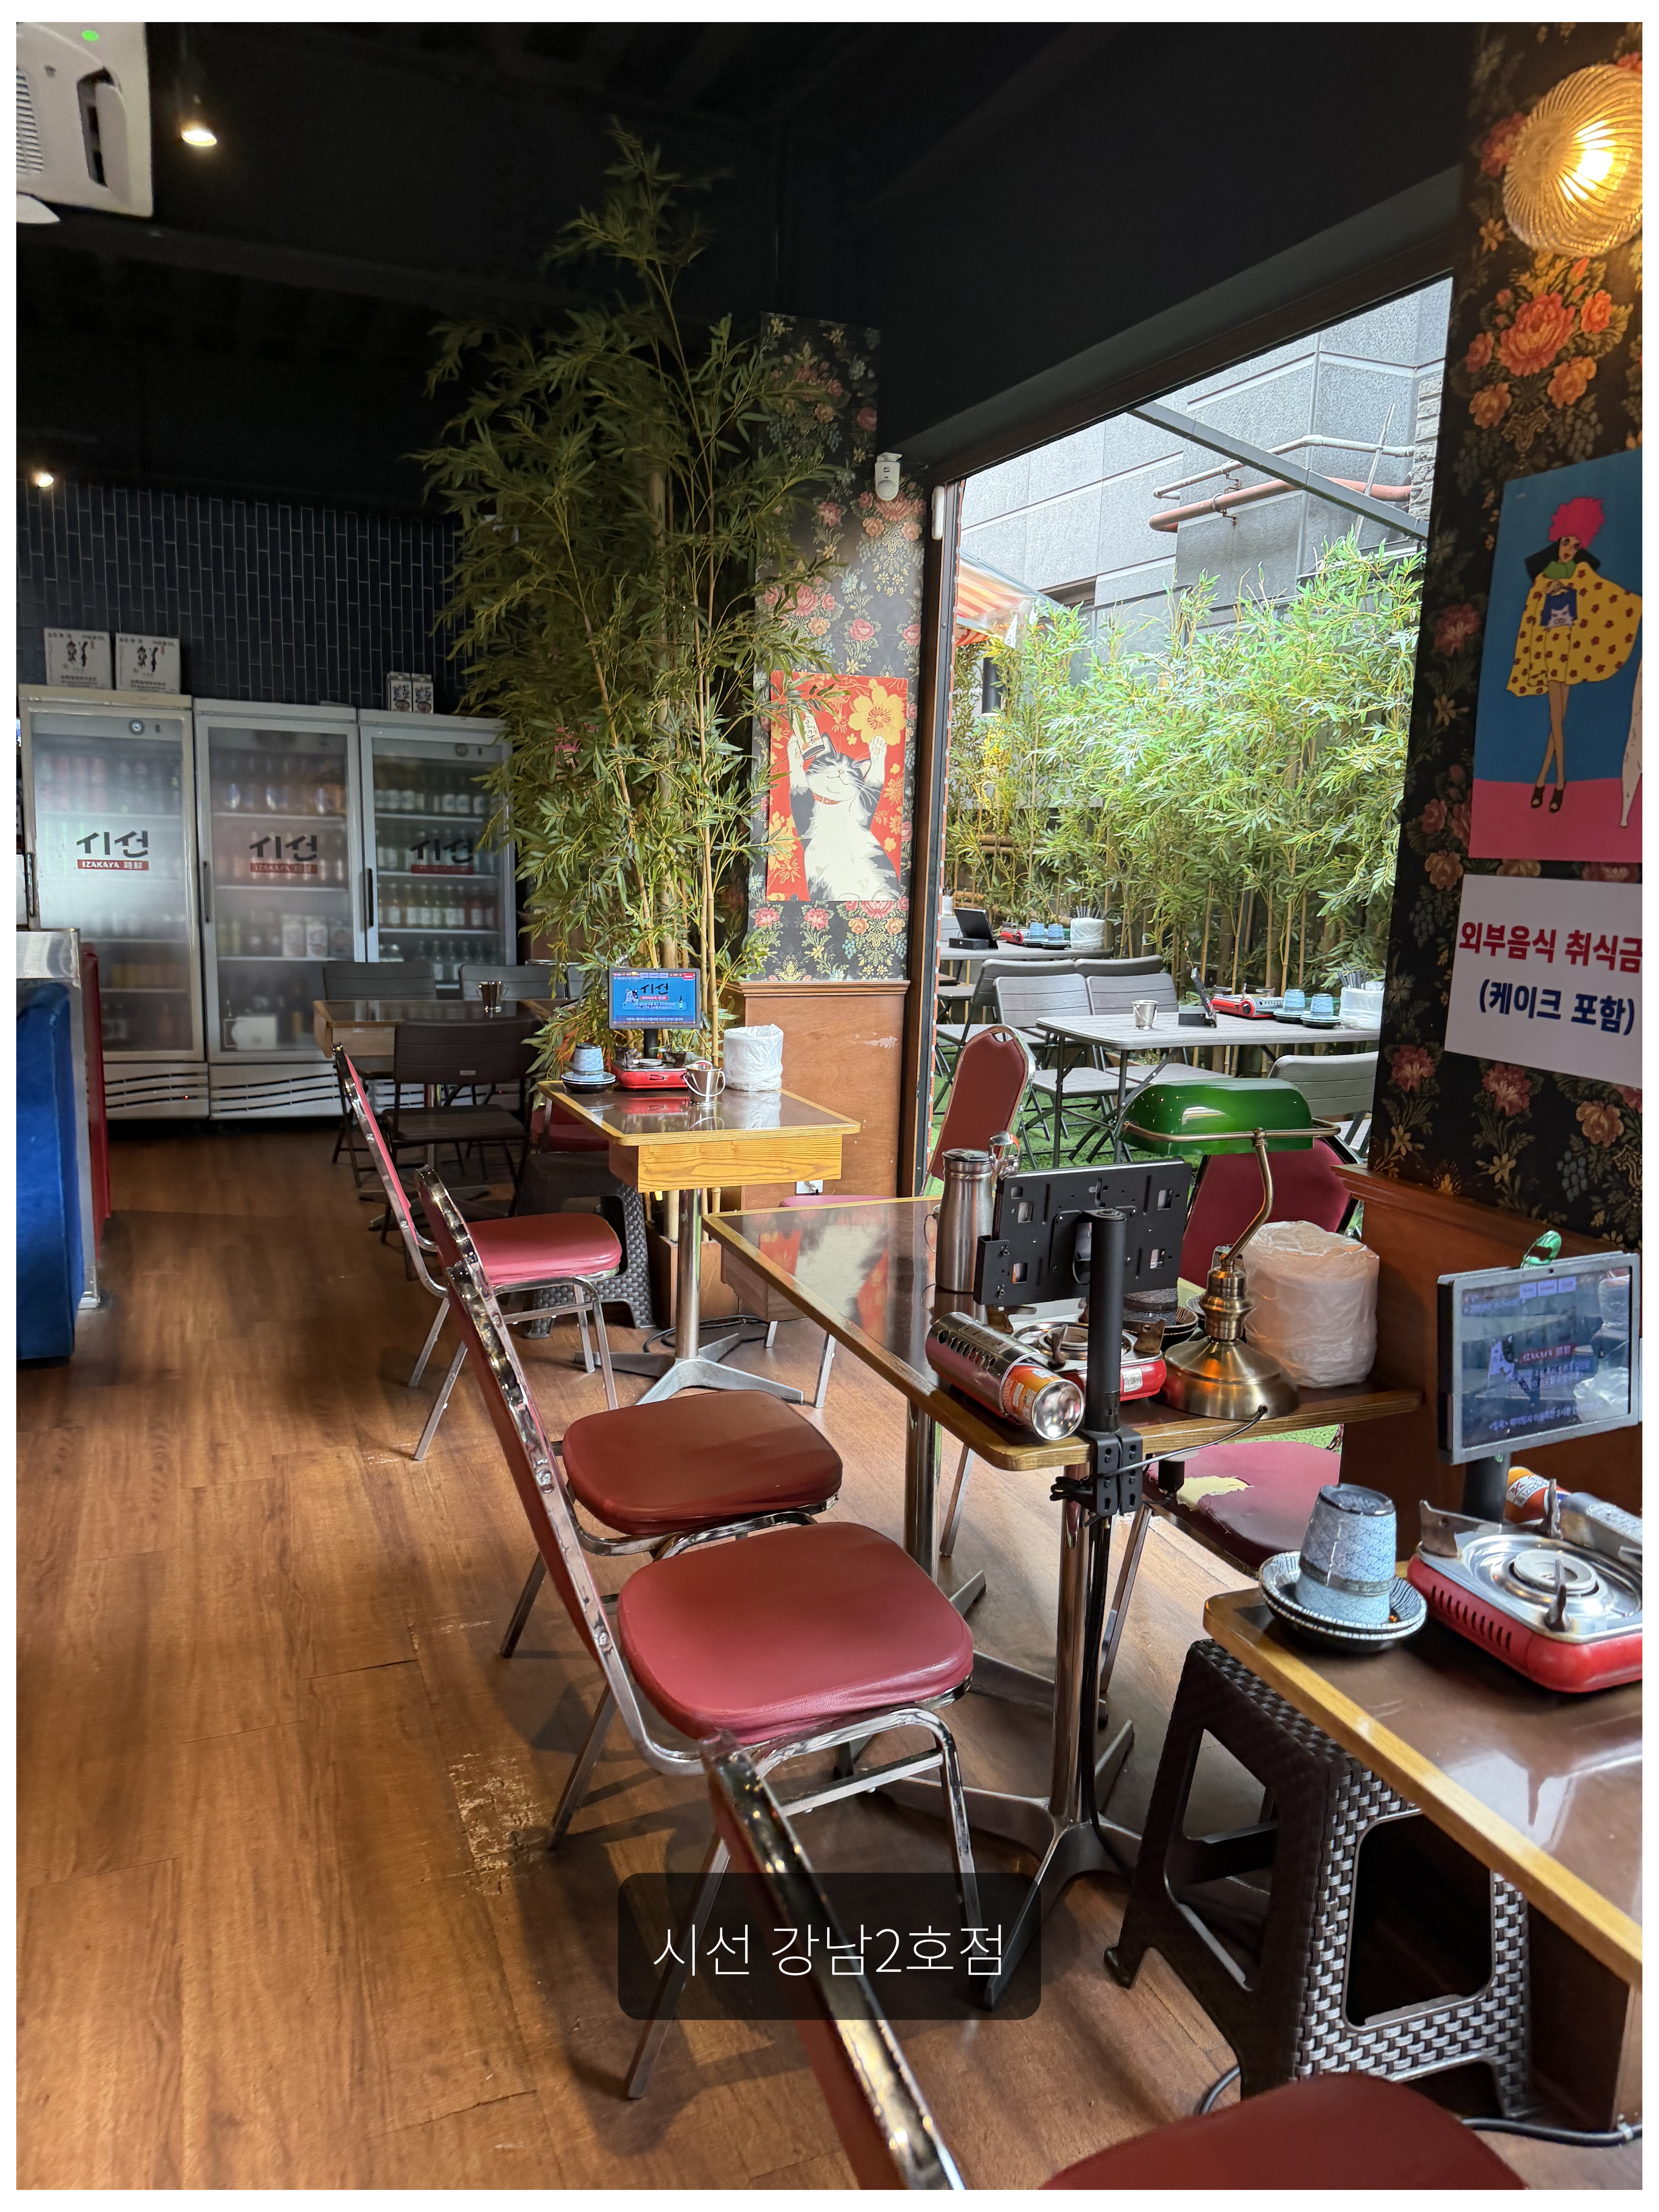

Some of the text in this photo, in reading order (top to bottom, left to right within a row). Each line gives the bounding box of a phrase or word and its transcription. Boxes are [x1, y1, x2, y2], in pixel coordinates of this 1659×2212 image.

[1458, 921, 1643, 973] 외부음식 취식금
[1479, 979, 1635, 1036] (케이크 포함)
